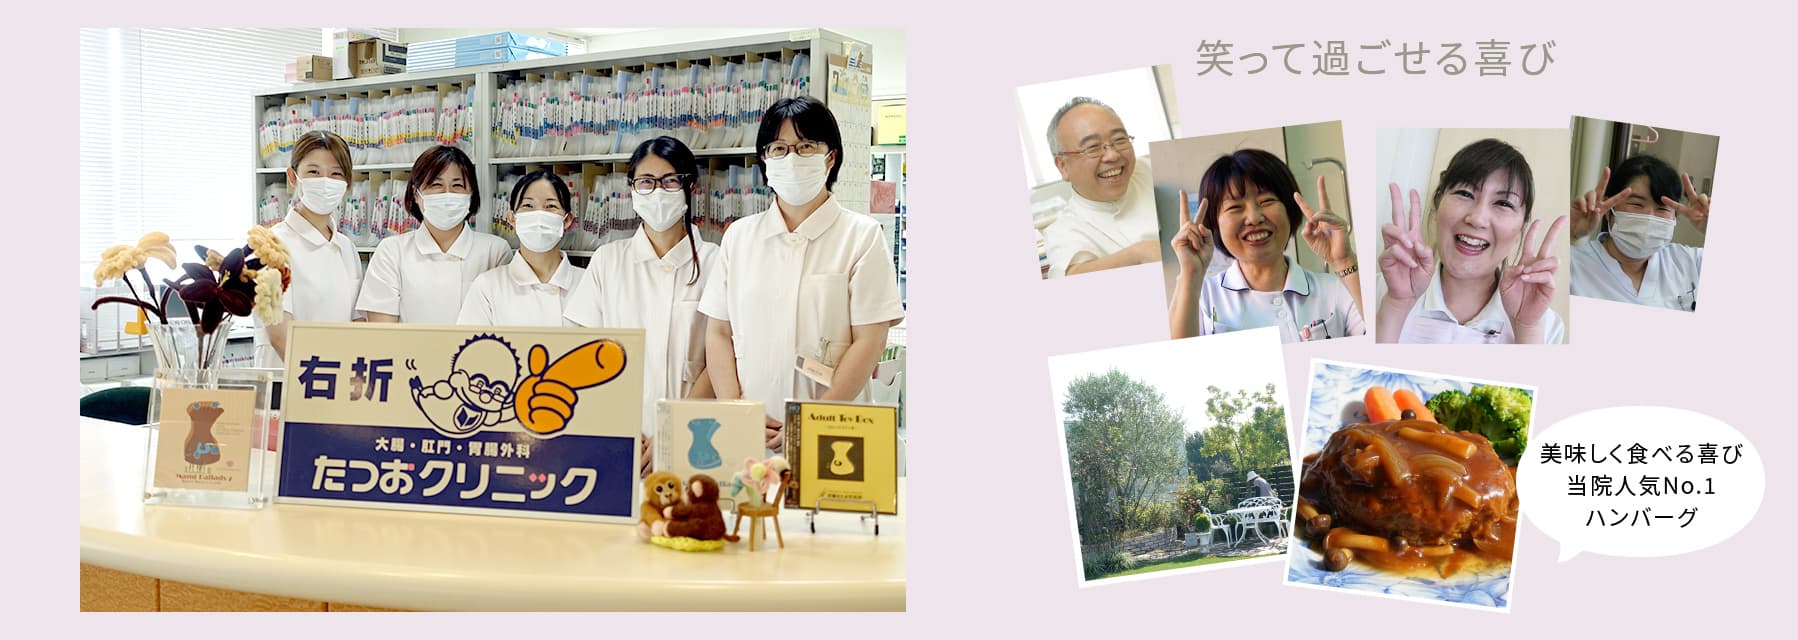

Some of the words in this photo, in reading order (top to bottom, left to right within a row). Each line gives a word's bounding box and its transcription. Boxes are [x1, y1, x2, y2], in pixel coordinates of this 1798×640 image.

[298, 356, 393, 402] 右折
[312, 455, 597, 505] たつおクリニック
